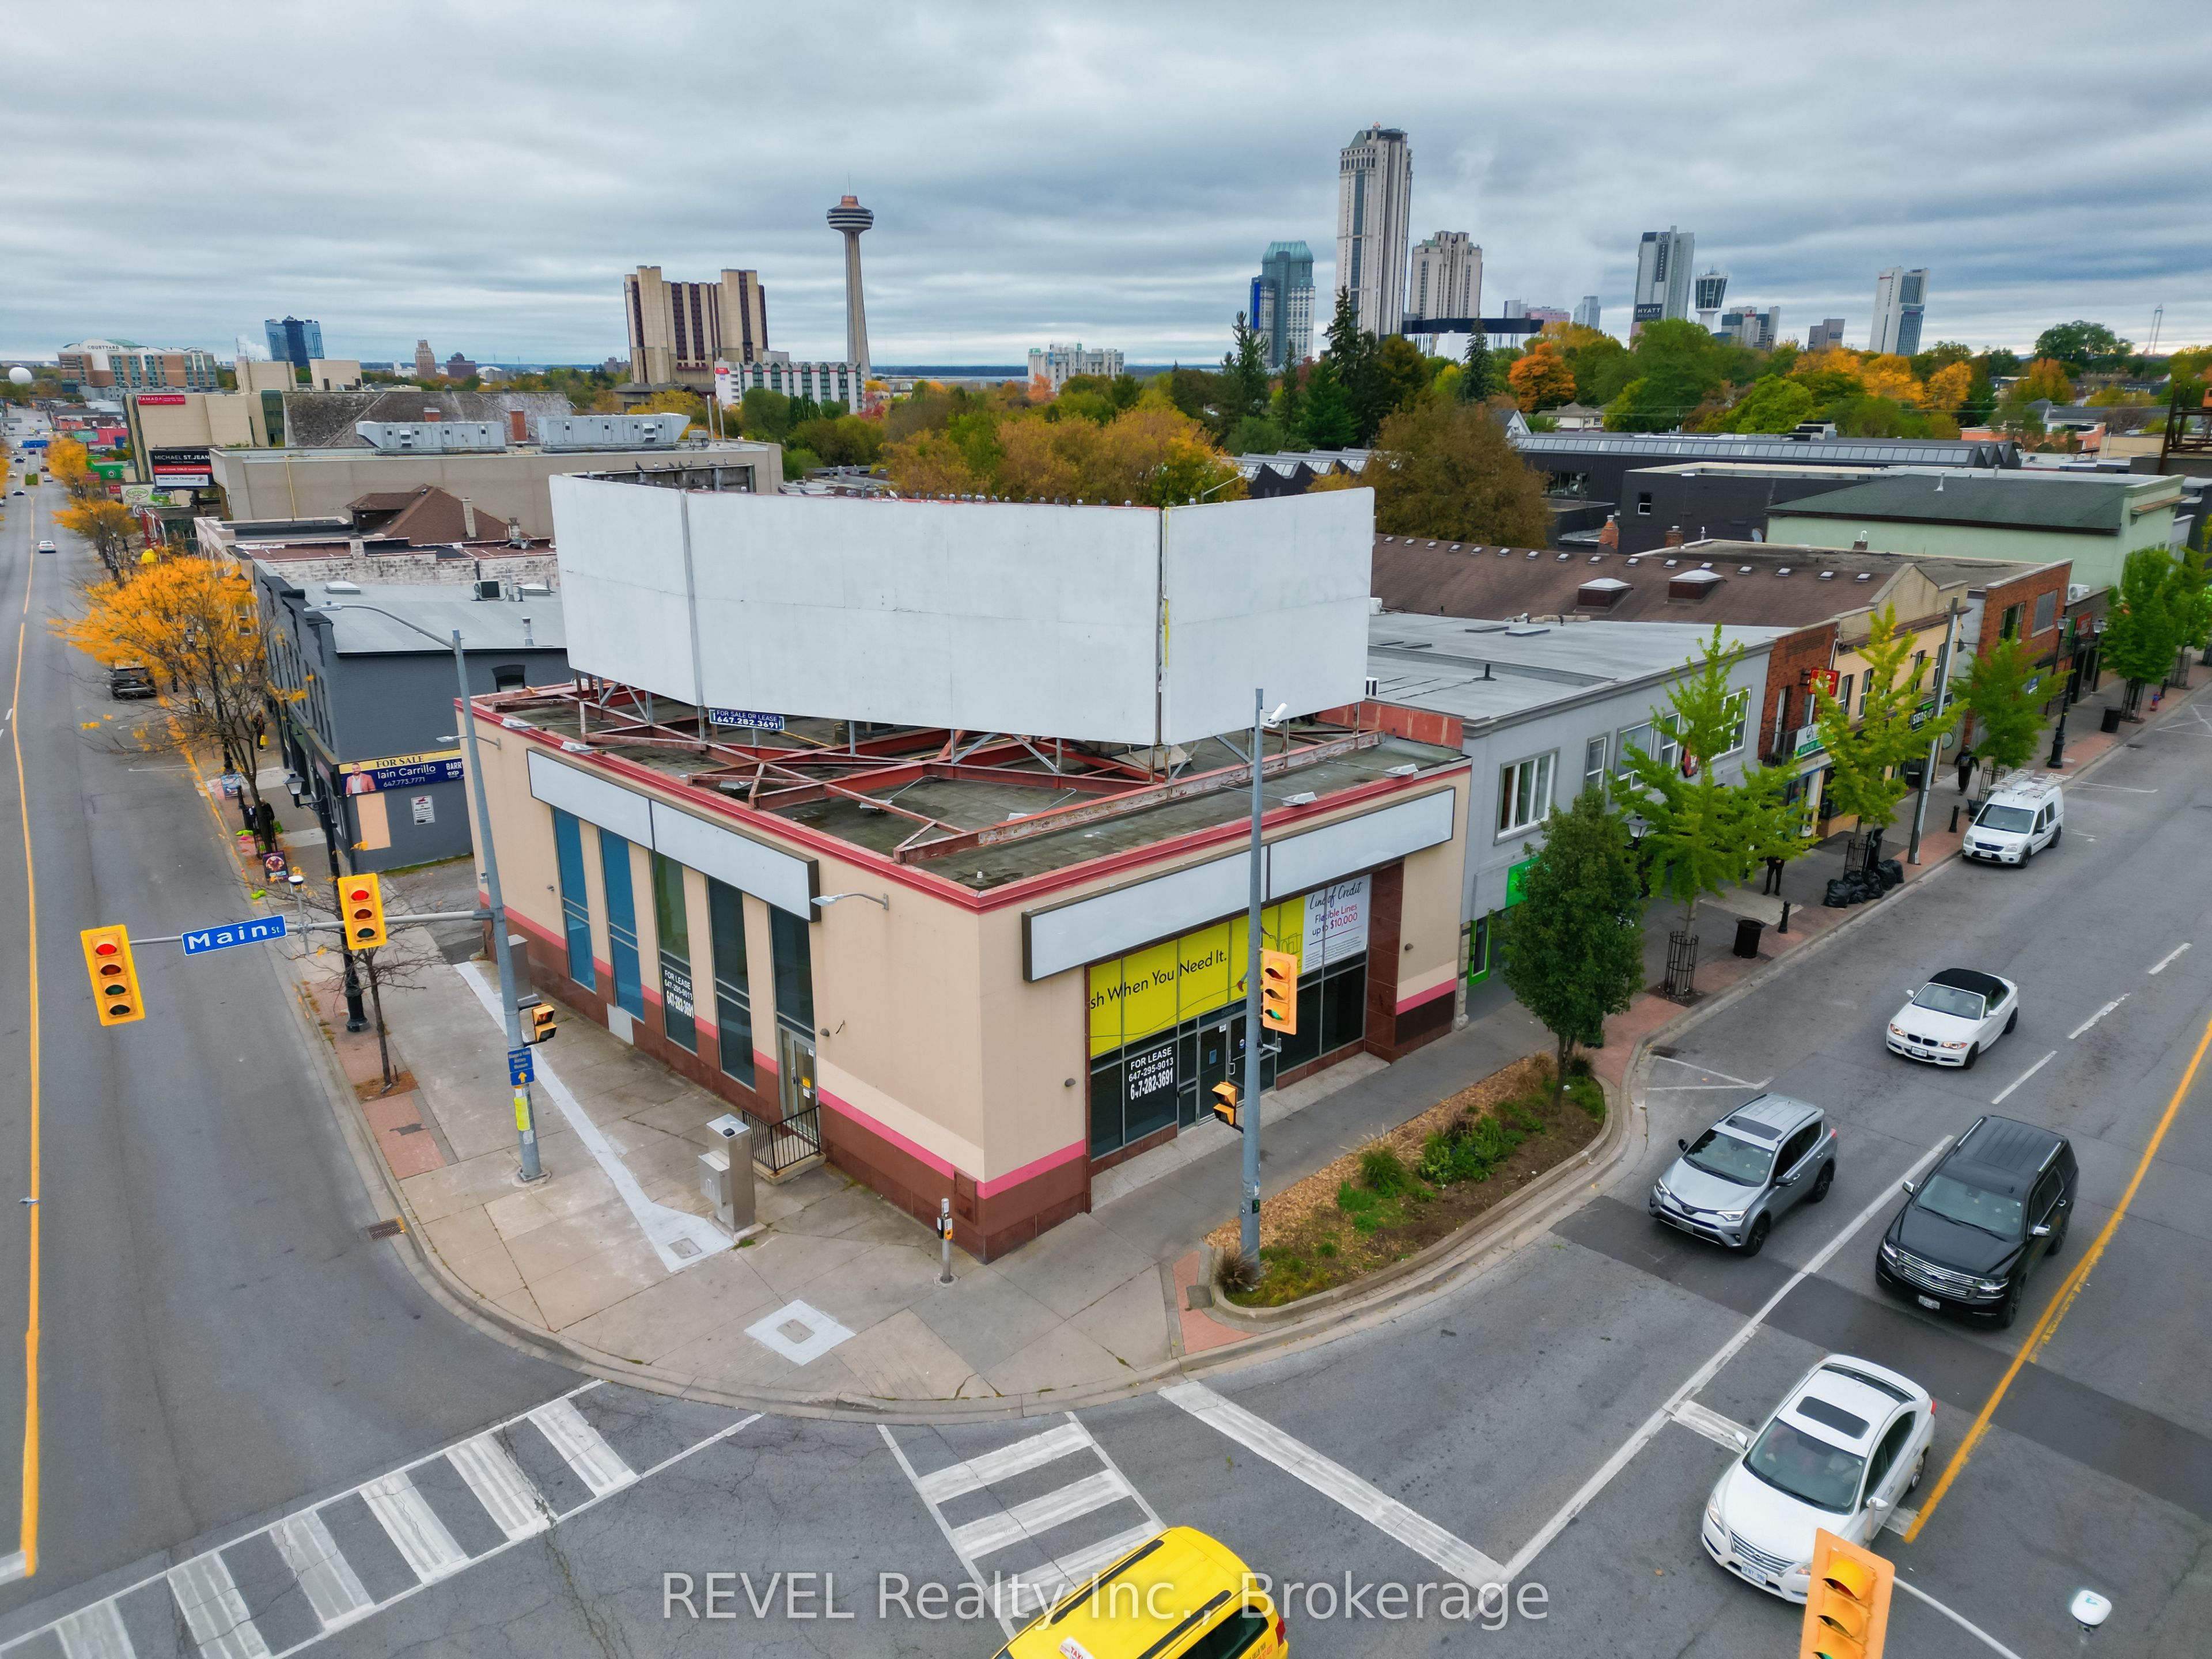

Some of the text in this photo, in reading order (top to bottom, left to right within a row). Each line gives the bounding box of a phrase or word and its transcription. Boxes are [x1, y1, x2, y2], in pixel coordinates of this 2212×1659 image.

[717, 716, 778, 729] 647.282.3691
[758, 714, 778, 722] LEASE
[376, 759, 397, 768] FOR
[400, 755, 425, 765] SALE
[377, 764, 436, 779] Iain Carrillo
[1338, 881, 1363, 900] Credit
[1341, 904, 1358, 915] Lines
[1312, 927, 1321, 937] up
[1330, 912, 1358, 930] $10,000
[188, 925, 283, 950] Main St.
[664, 969, 691, 990] FOR LEASE
[1107, 979, 1149, 1002] When
[1152, 969, 1175, 986] You
[1179, 950, 1213, 977] Need
[1216, 949, 1227, 964] It.
[1131, 1046, 1172, 1070] FOR LEASE
[1129, 1057, 1173, 1082] 647-295-9013
